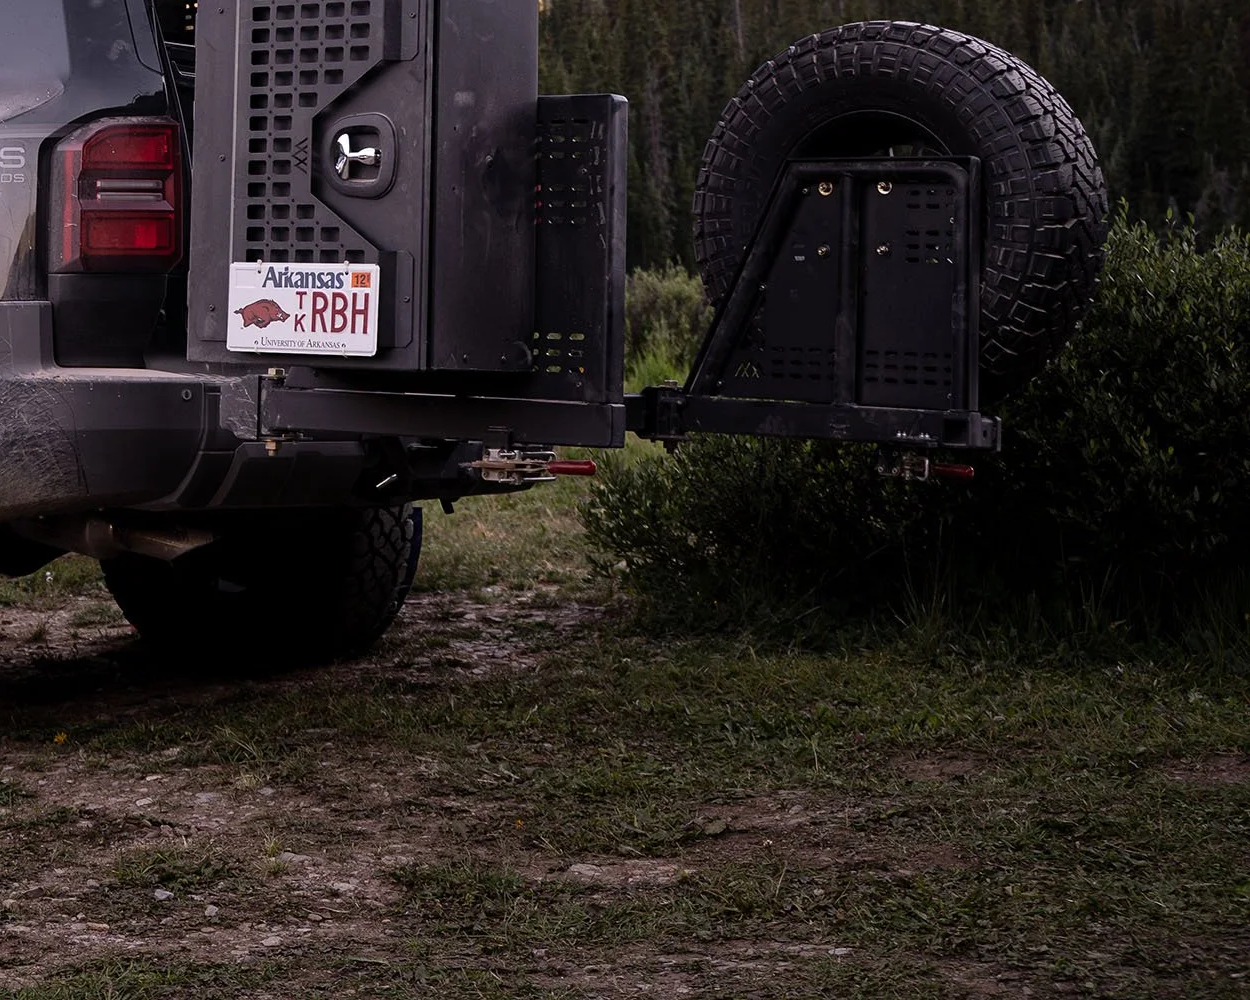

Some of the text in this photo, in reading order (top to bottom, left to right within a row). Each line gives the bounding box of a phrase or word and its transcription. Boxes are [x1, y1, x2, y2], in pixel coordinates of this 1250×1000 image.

[261, 266, 345, 289] Arkansas
[354, 274, 366, 285] 12
[295, 291, 307, 310] T
[310, 291, 370, 334] RBH
[294, 314, 306, 332] K
